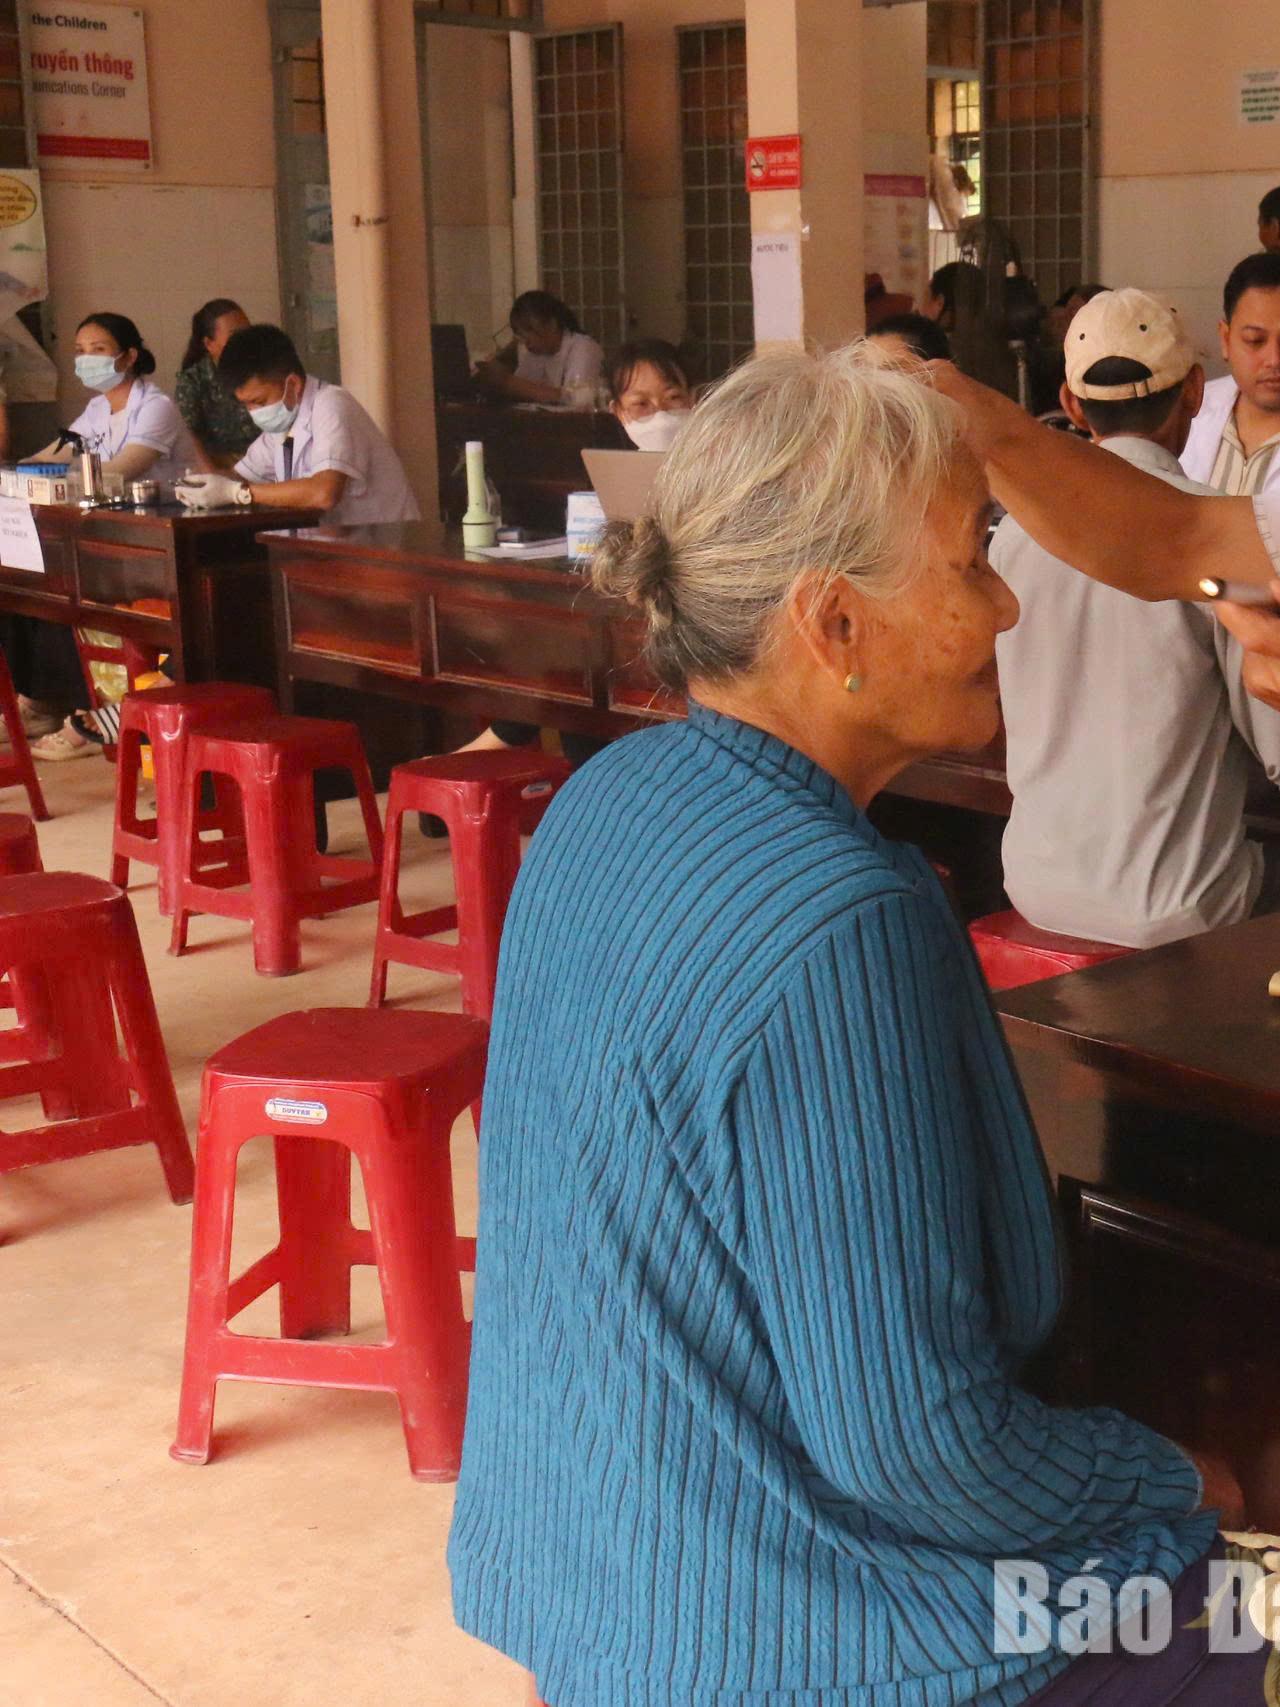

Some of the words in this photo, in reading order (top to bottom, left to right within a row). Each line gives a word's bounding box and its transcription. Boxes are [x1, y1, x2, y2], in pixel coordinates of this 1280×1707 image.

[31, 13, 52, 26] the
[54, 15, 107, 31] Children
[84, 50, 134, 81] thông
[91, 81, 126, 98] Corner
